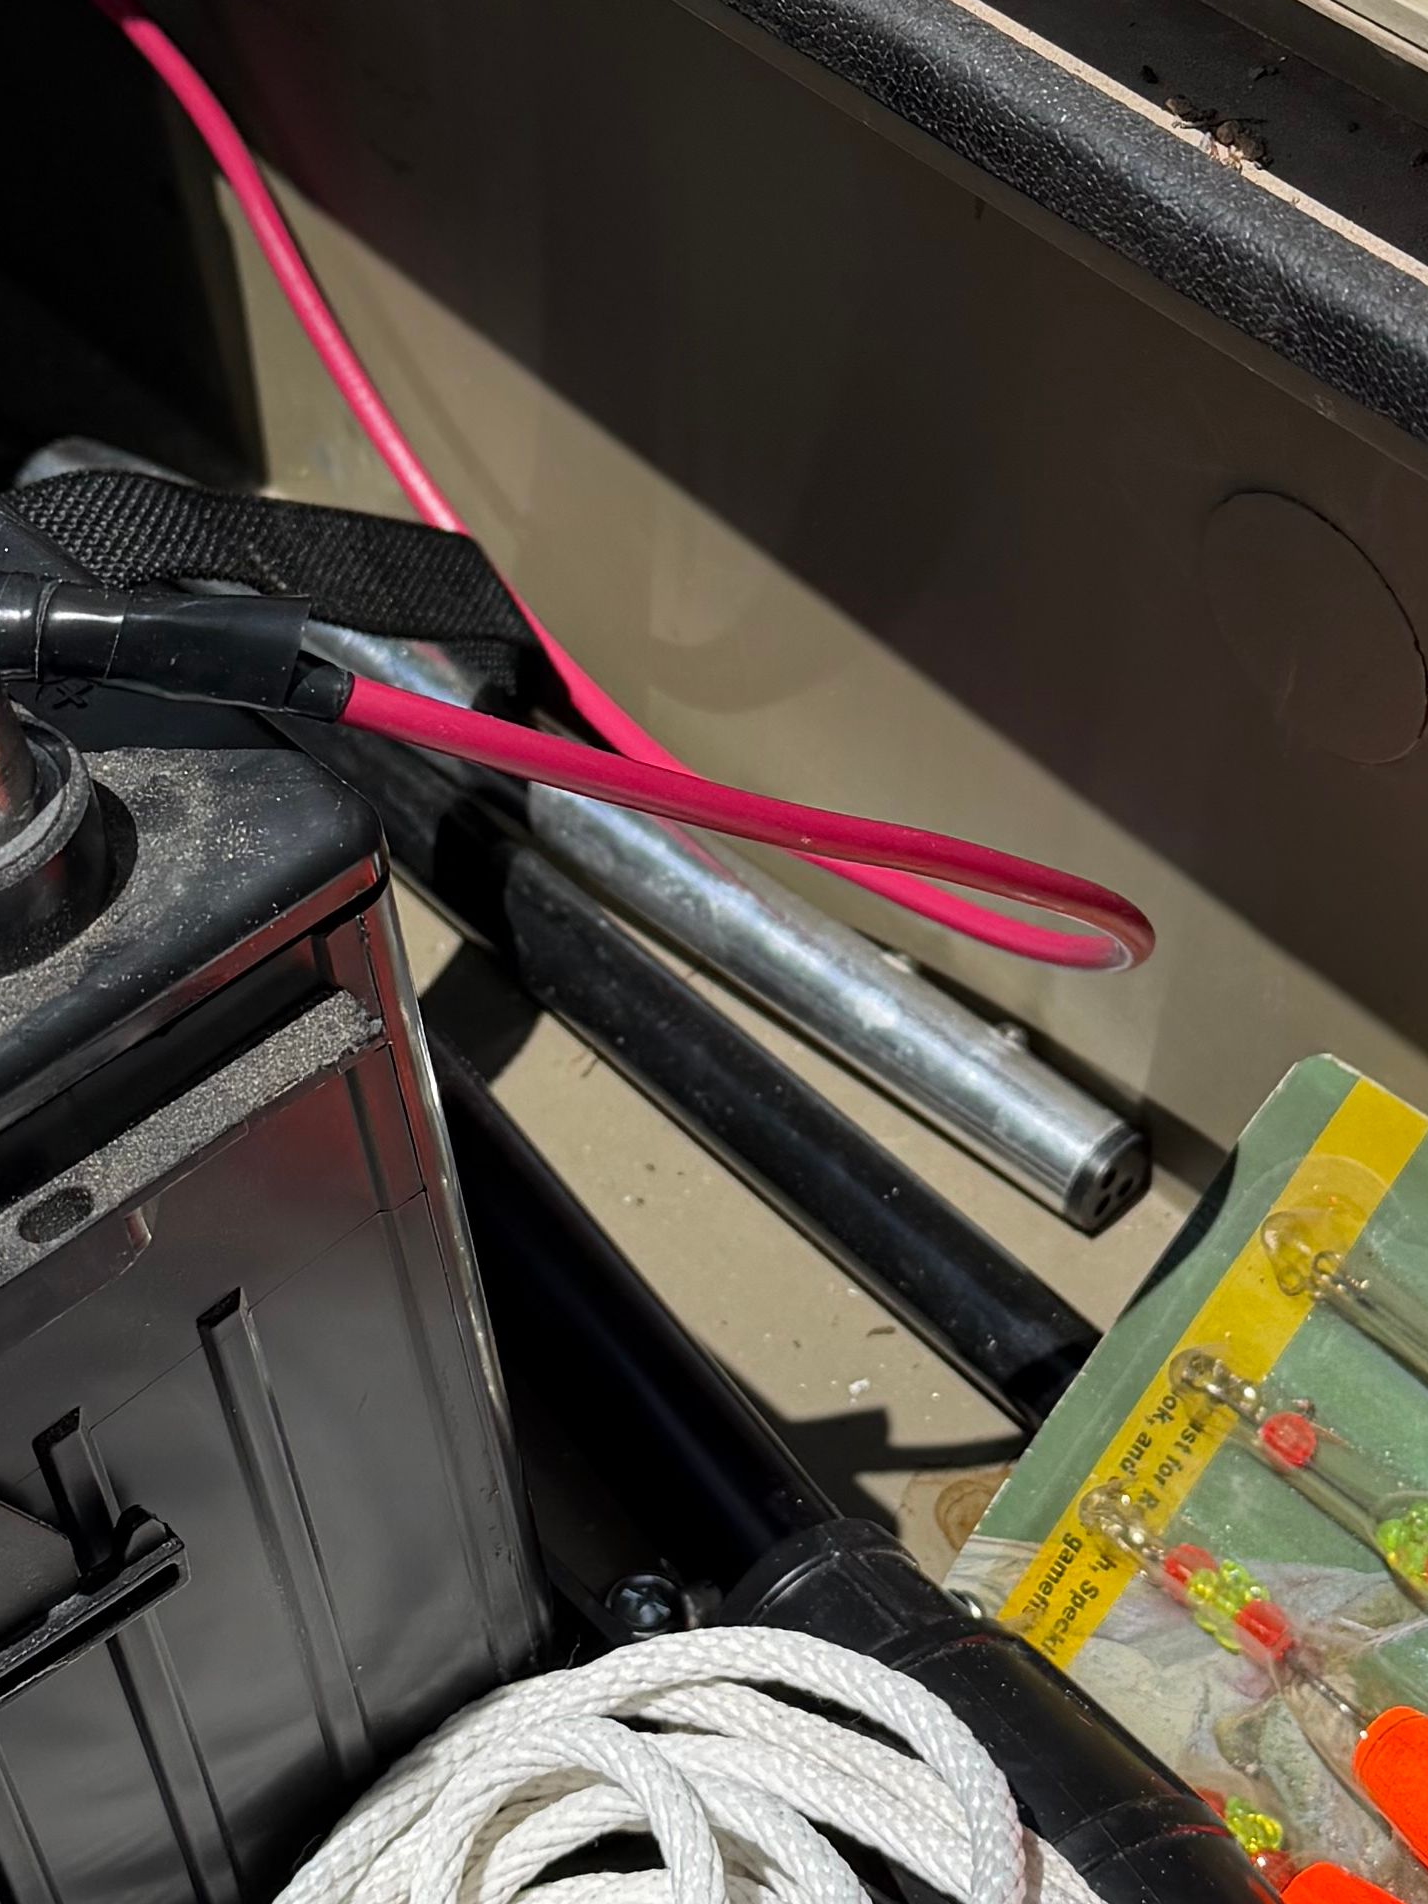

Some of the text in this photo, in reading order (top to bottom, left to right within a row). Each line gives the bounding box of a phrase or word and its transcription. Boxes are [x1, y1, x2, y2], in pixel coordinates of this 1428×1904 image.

[1115, 1428, 1157, 1478] and
[1149, 1451, 1187, 1491] for
[1034, 1573, 1103, 1662] Speckl
